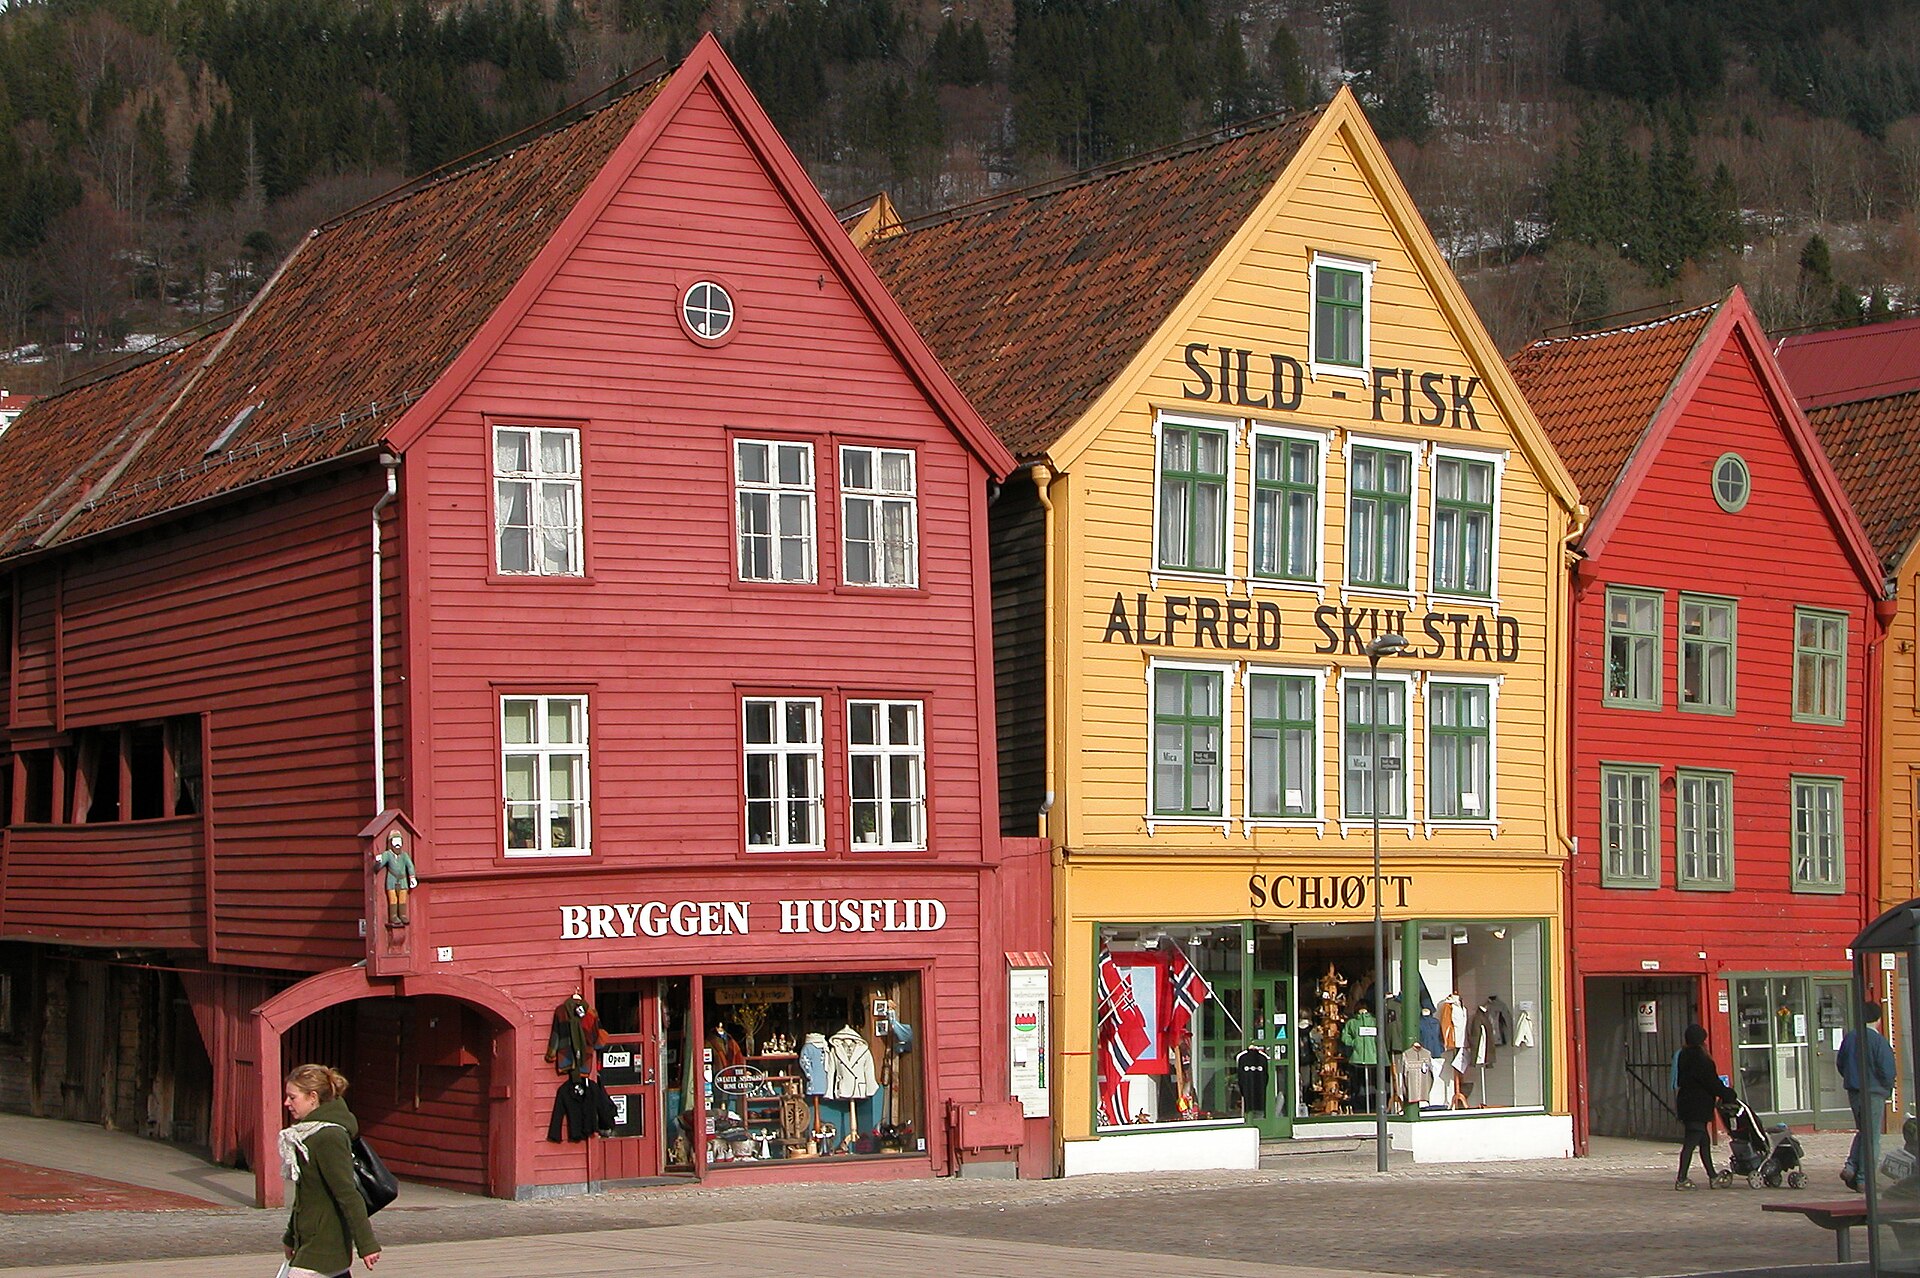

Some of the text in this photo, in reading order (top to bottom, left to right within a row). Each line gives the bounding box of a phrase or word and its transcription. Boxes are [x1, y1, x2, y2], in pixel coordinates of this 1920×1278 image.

[1183, 342, 1304, 411] SILD
[1372, 366, 1482, 430] FISK
[1102, 591, 1282, 651] ALFRED
[1249, 874, 1413, 909] SCHJØTT
[559, 898, 947, 940] BRYGGEN HUSFLID
[607, 1054, 626, 1066] Open
